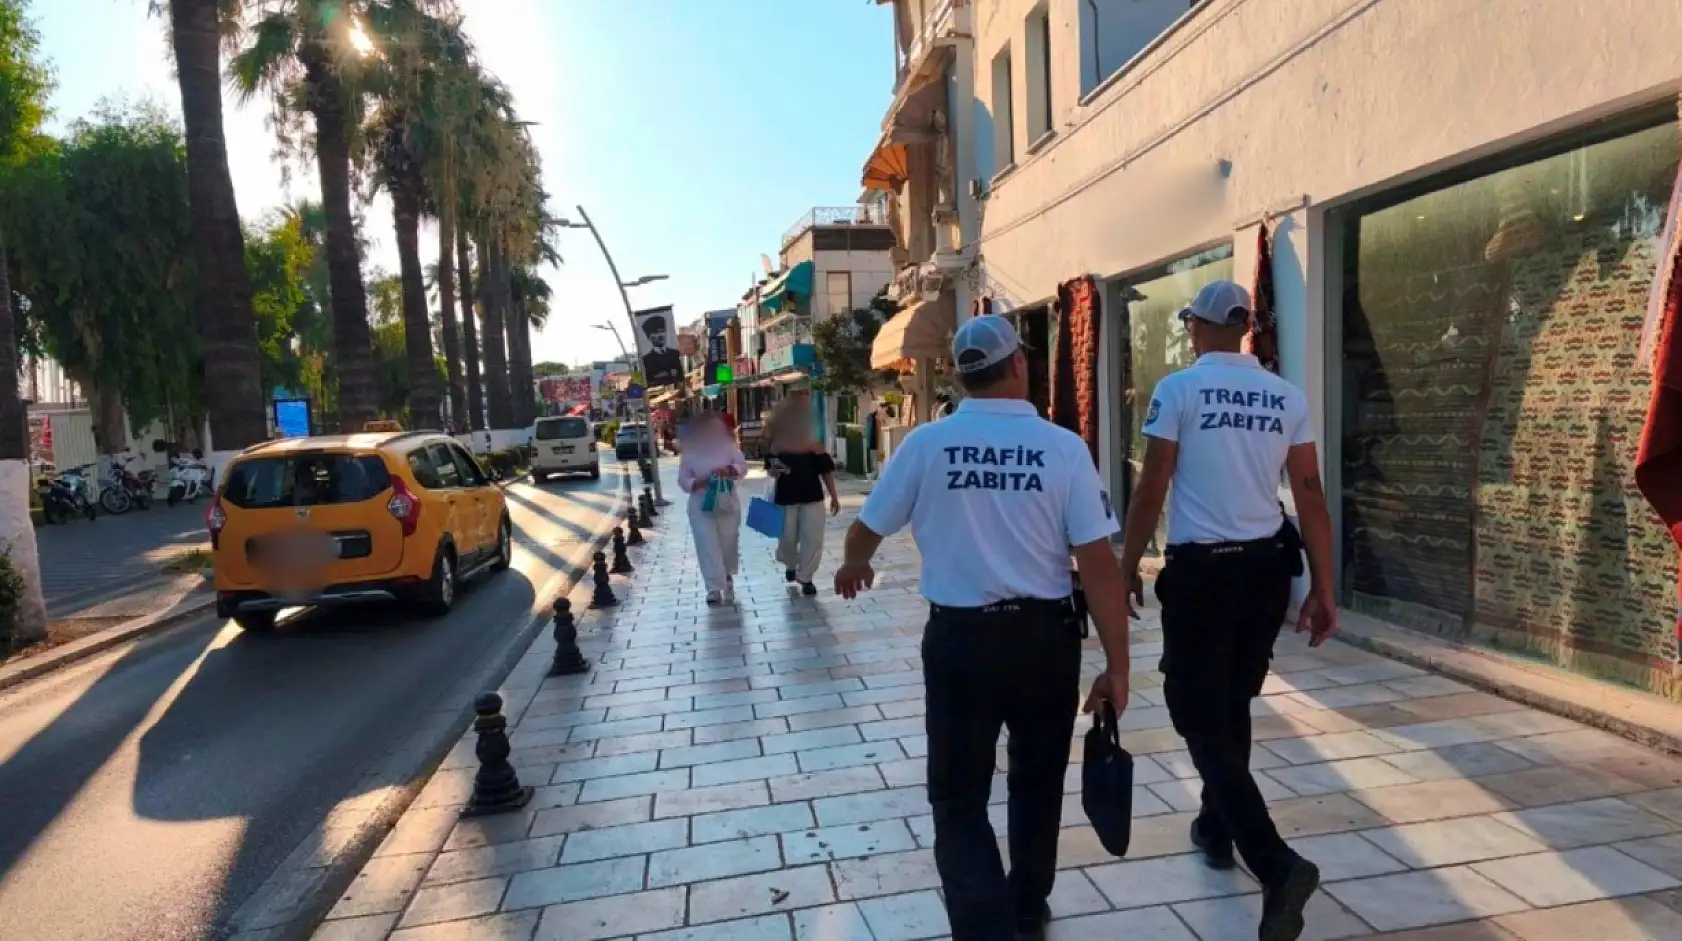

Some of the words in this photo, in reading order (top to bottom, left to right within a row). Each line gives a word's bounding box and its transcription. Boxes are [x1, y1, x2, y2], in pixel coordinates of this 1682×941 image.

[1199, 388, 1286, 411] TRAFİK
[1200, 412, 1284, 434] ZABITA
[943, 445, 1045, 467] TRAFİK
[947, 470, 1043, 492] ZABITA
